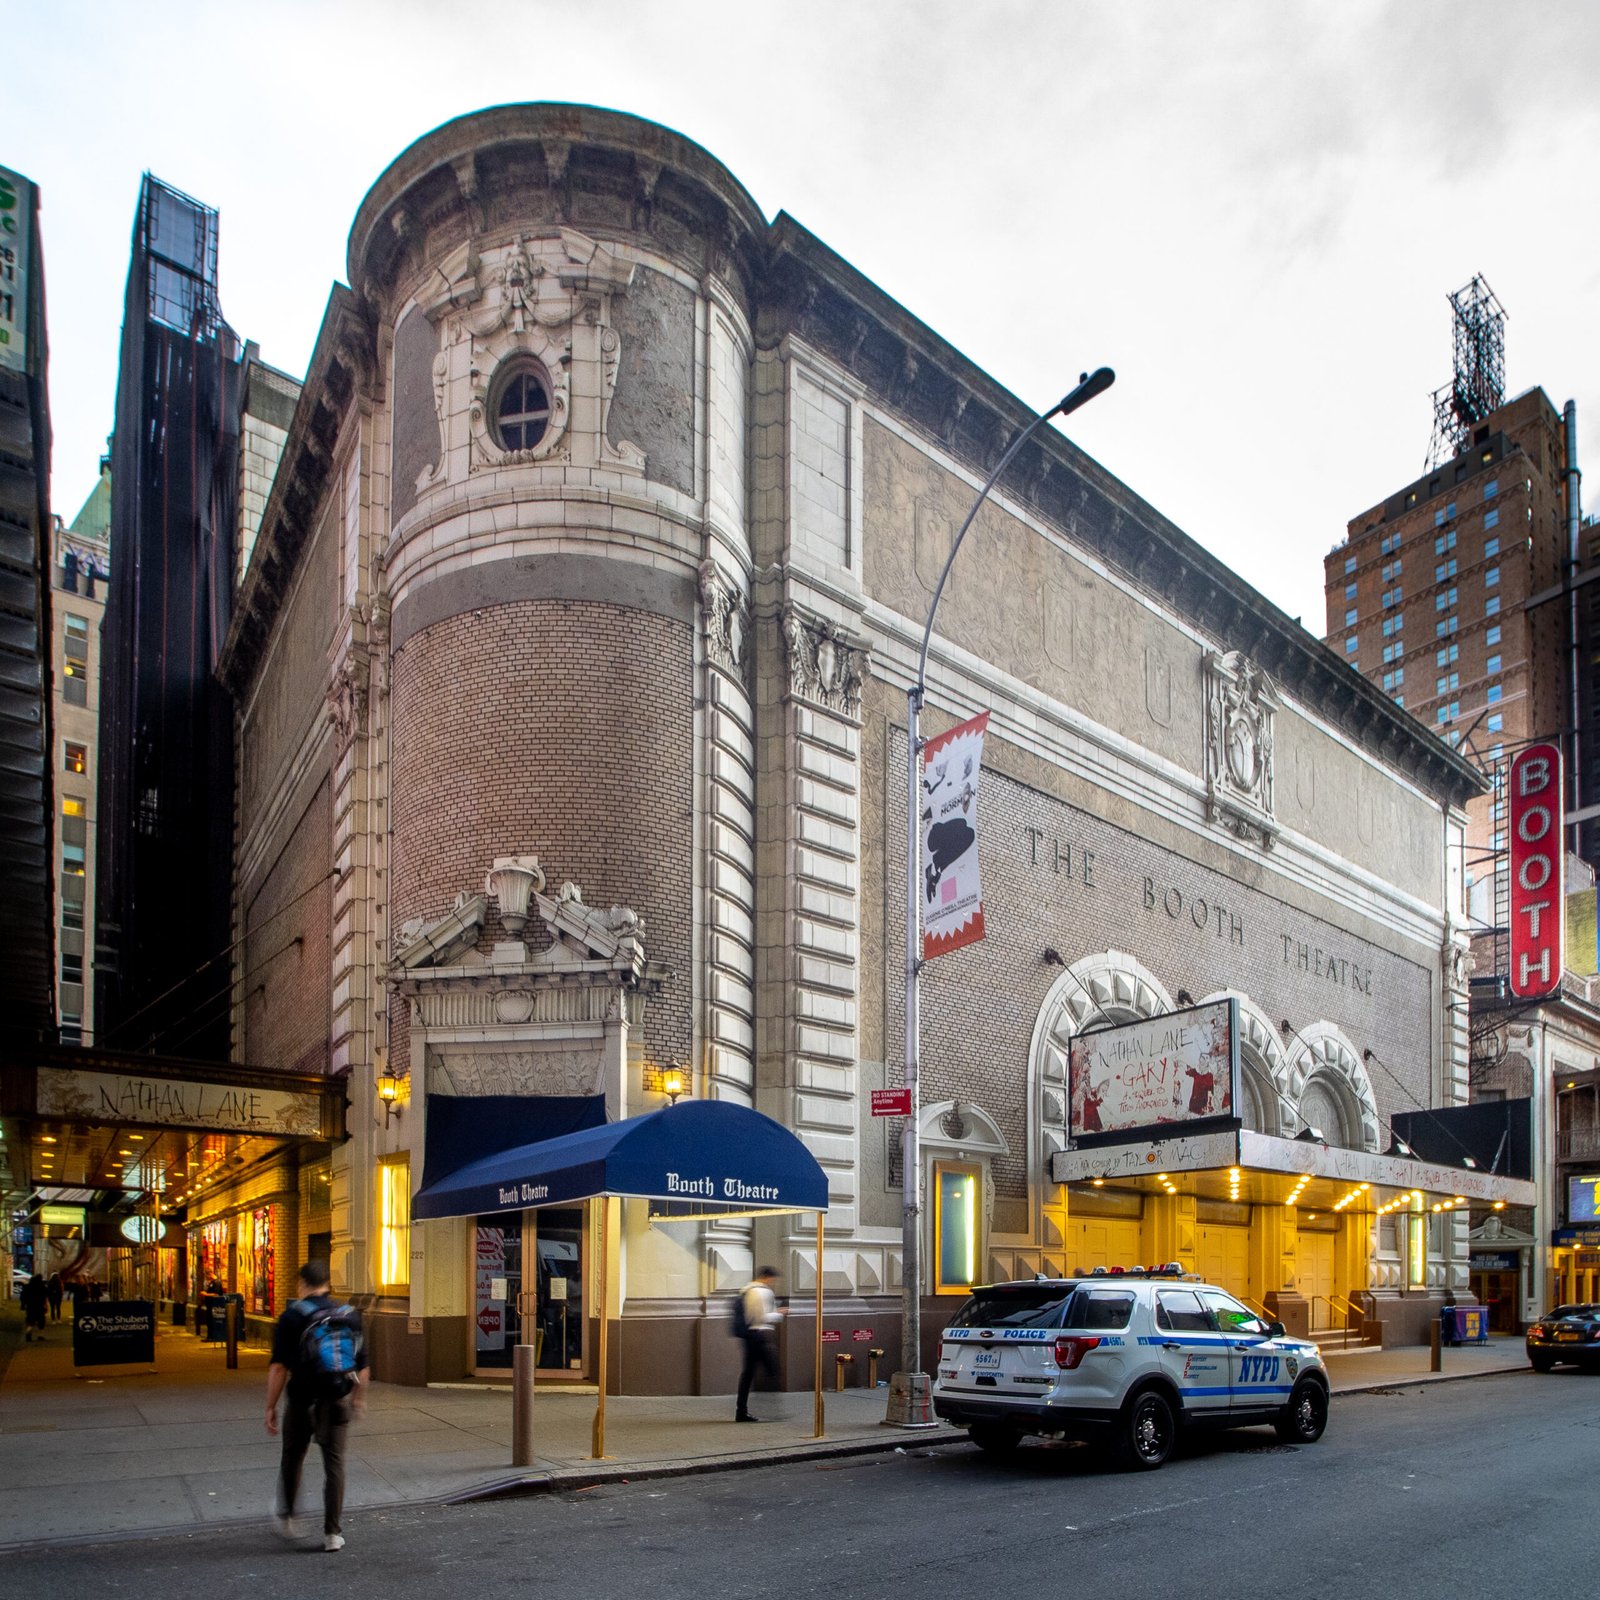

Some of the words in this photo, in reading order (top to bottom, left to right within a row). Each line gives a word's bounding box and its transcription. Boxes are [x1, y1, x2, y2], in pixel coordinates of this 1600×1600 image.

[1518, 756, 1552, 988] BOOTH
[1025, 826, 1096, 888] THE
[1143, 876, 1244, 946] BOOTH
[1280, 934, 1373, 996] THEATRE
[1098, 1036, 1144, 1068] NATHAN
[1149, 1027, 1193, 1057] LANE
[1122, 1057, 1167, 1088] GARY
[99, 1075, 185, 1117] NATHAN
[197, 1085, 270, 1121] LANE
[499, 1187, 519, 1205] Booth
[521, 1183, 549, 1202] Theatre
[666, 1172, 715, 1197] Booth
[723, 1178, 780, 1200] Theatre
[411, 1251, 424, 1259] 222
[96, 1323, 149, 1333] Organization
[97, 1316, 114, 1324] The
[115, 1314, 149, 1324] Shubert
[949, 1330, 970, 1338] NYPD
[1003, 1330, 1047, 1339] POLICE
[1109, 1337, 1122, 1346] 4567
[975, 1354, 992, 1363] 4567
[1238, 1355, 1280, 1382] NYPD
